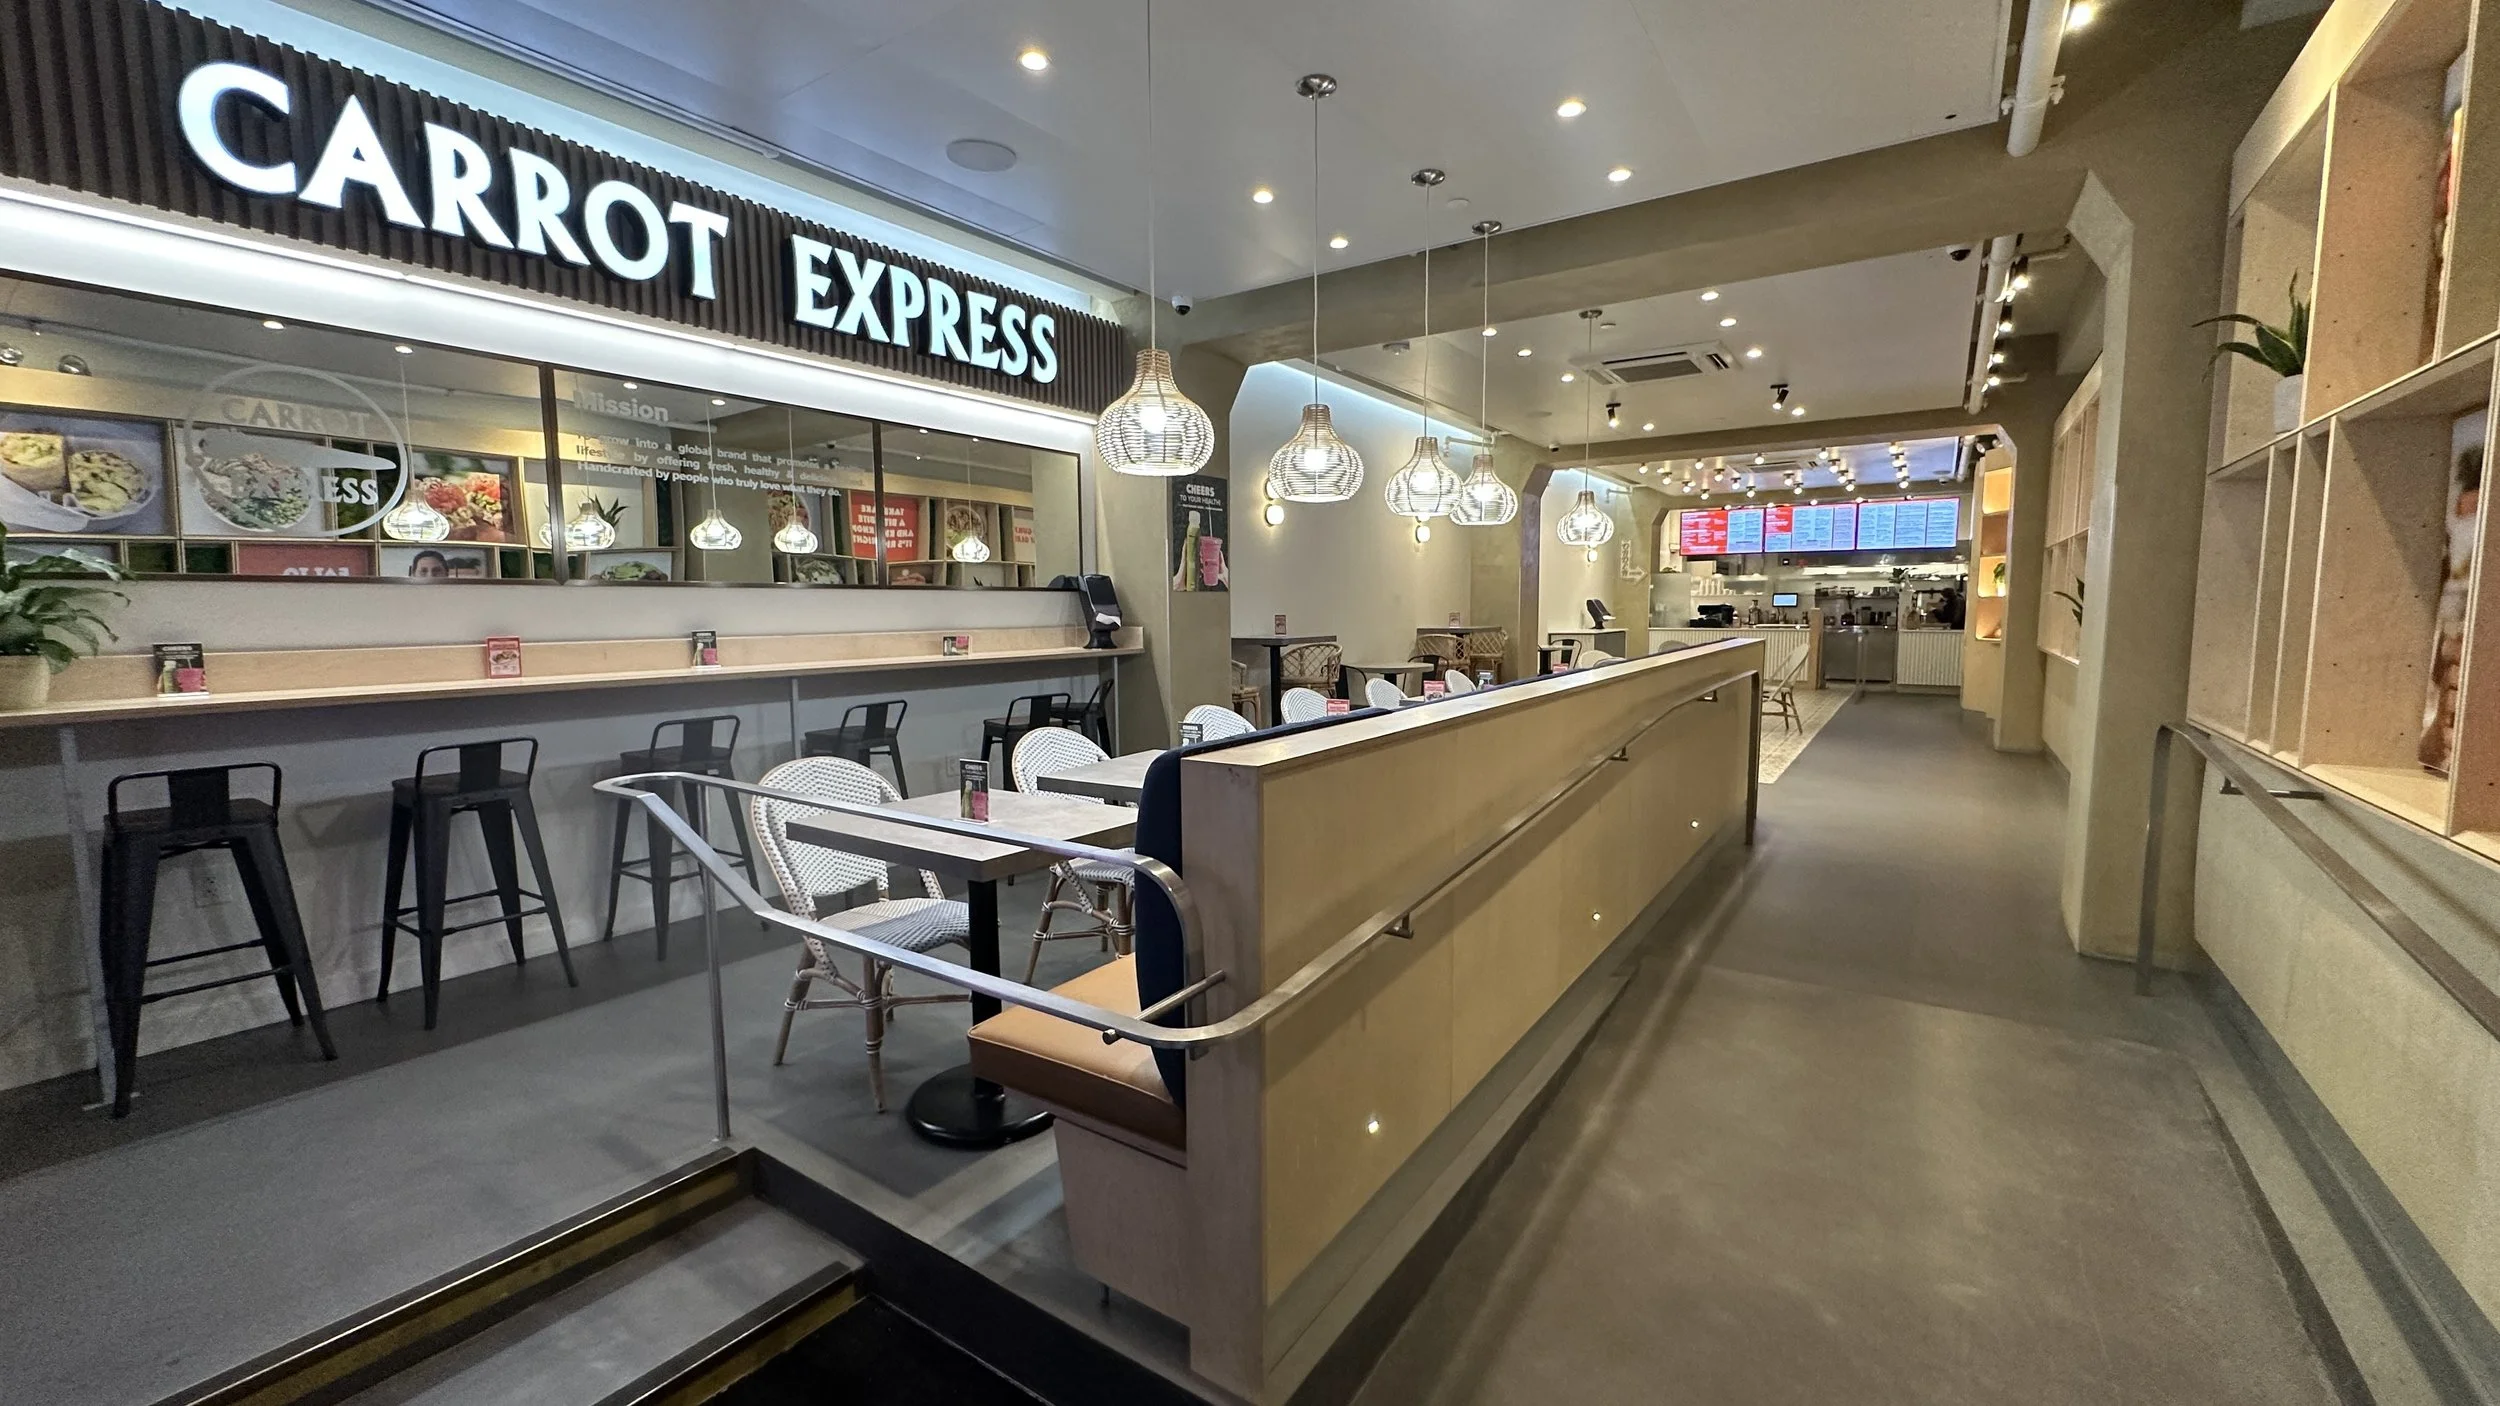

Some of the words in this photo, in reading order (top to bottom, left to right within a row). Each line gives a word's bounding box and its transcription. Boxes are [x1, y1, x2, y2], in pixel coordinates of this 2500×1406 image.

[179, 62, 730, 300] CARROT
[792, 233, 1058, 384] EXPRESS
[222, 398, 371, 437] CARROT
[573, 390, 669, 422] Mission
[633, 452, 649, 464] by
[656, 455, 700, 471] offering
[744, 463, 780, 479] healthy
[635, 438, 659, 450] into
[664, 443, 672, 451] a
[677, 444, 712, 457] global
[717, 448, 747, 460] brand
[752, 453, 772, 464] that
[577, 461, 653, 478] Handcrafted
[655, 468, 670, 482] by
[672, 471, 710, 485] people
[711, 476, 734, 486] who
[735, 477, 759, 490] truly
[760, 480, 780, 490] love
[782, 483, 806, 493] what
[806, 486, 827, 497] they
[1186, 484, 1215, 496] CHEERS
